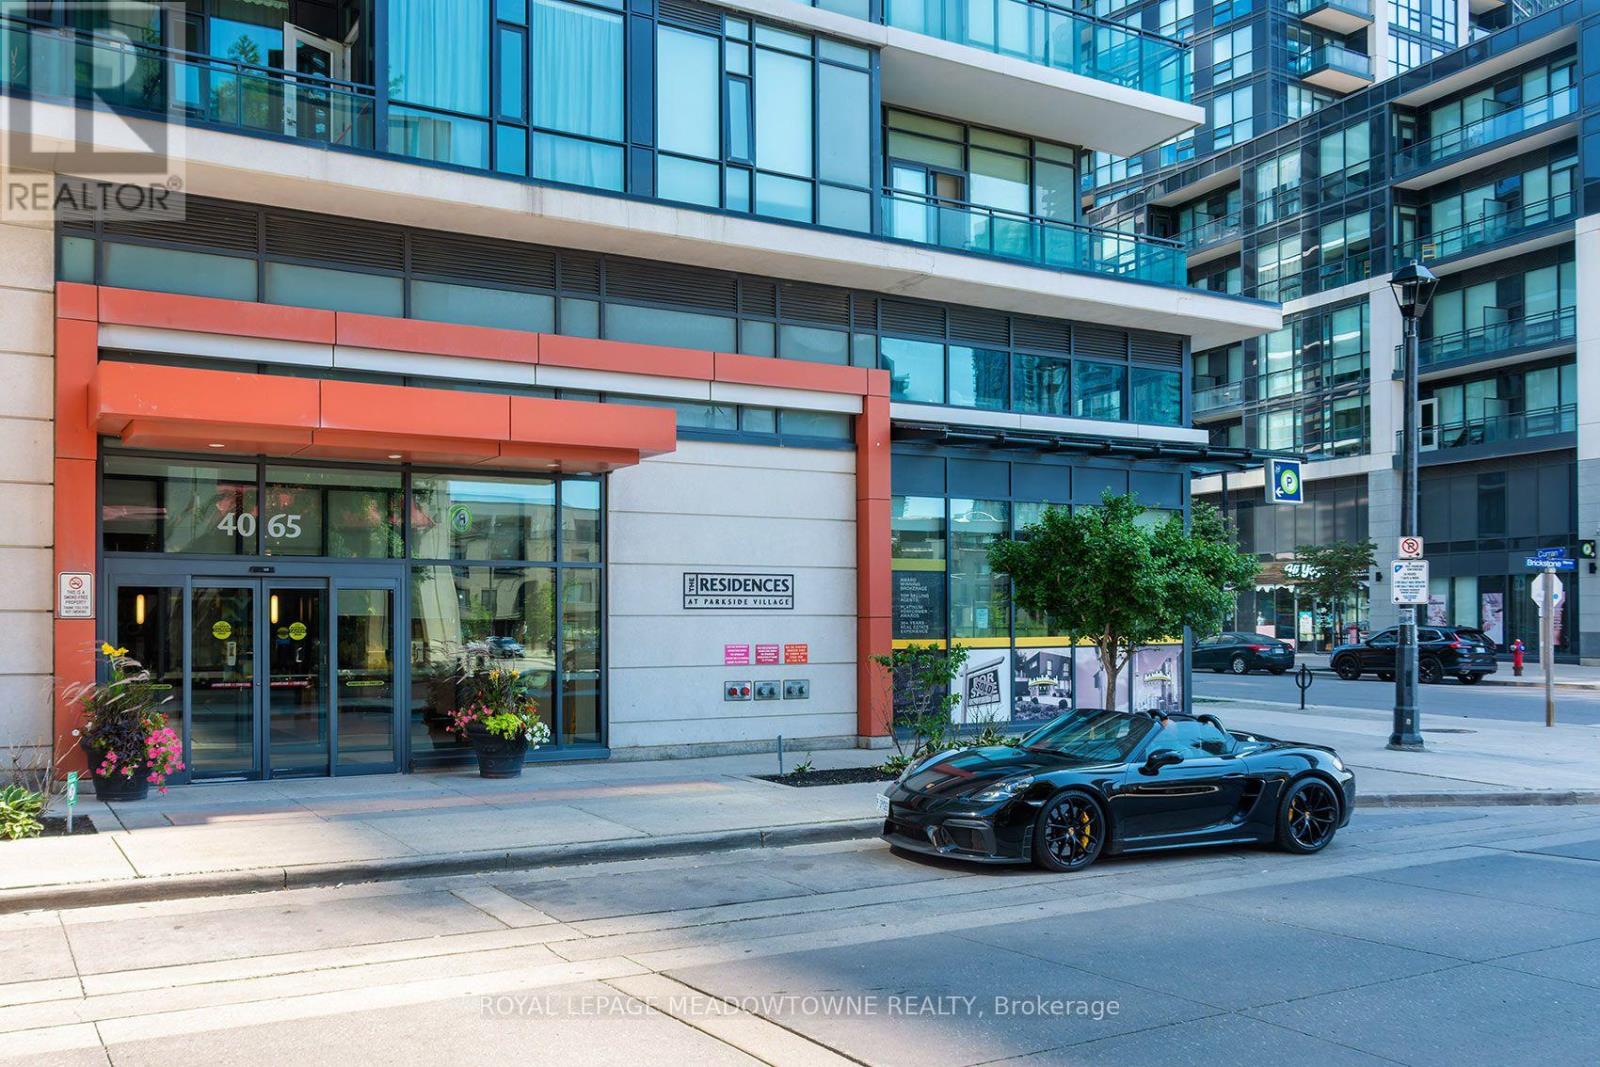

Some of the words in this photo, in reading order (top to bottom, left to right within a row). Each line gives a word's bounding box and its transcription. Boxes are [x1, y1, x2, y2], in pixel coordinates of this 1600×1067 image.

[1526, 559, 1562, 567] Brickstone
[700, 577, 790, 592] RESIDENCES
[704, 598, 748, 606] PARKSIDE
[753, 598, 790, 606] VILLAGE
[972, 672, 995, 686] FOR
[970, 682, 999, 698] SAE
[975, 681, 993, 694] SOLD
